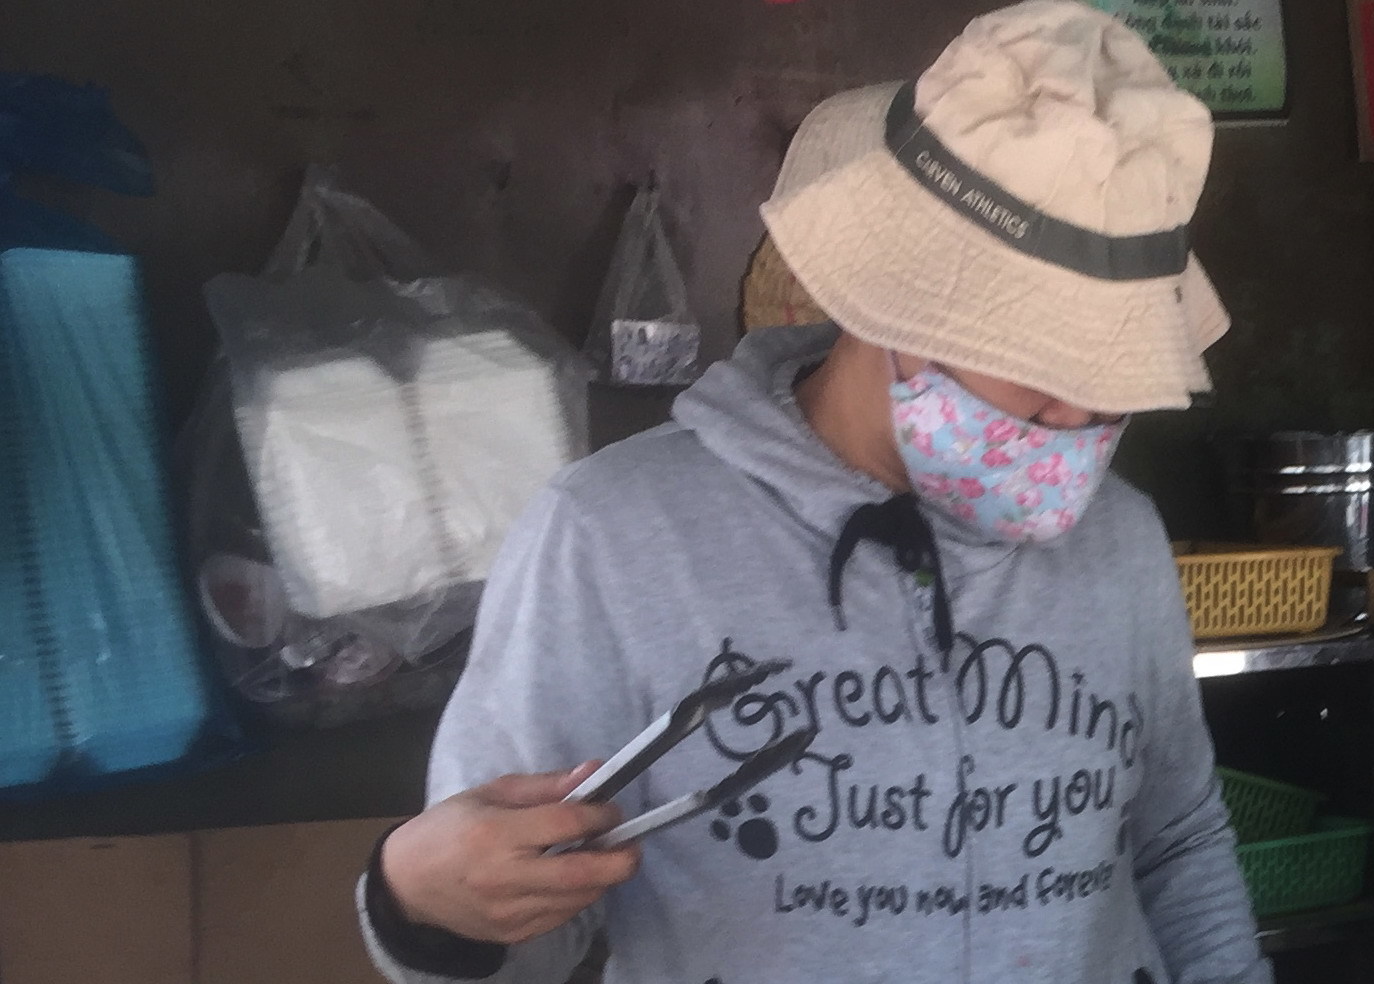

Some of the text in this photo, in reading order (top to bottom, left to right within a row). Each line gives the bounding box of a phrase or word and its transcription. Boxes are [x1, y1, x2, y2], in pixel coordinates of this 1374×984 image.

[961, 187, 1031, 239] ATHLETICS
[705, 637, 939, 760] Great
[793, 749, 1117, 861] Just for you
[774, 872, 849, 917] Love
[852, 884, 909, 929] you
[976, 872, 1031, 916] and
